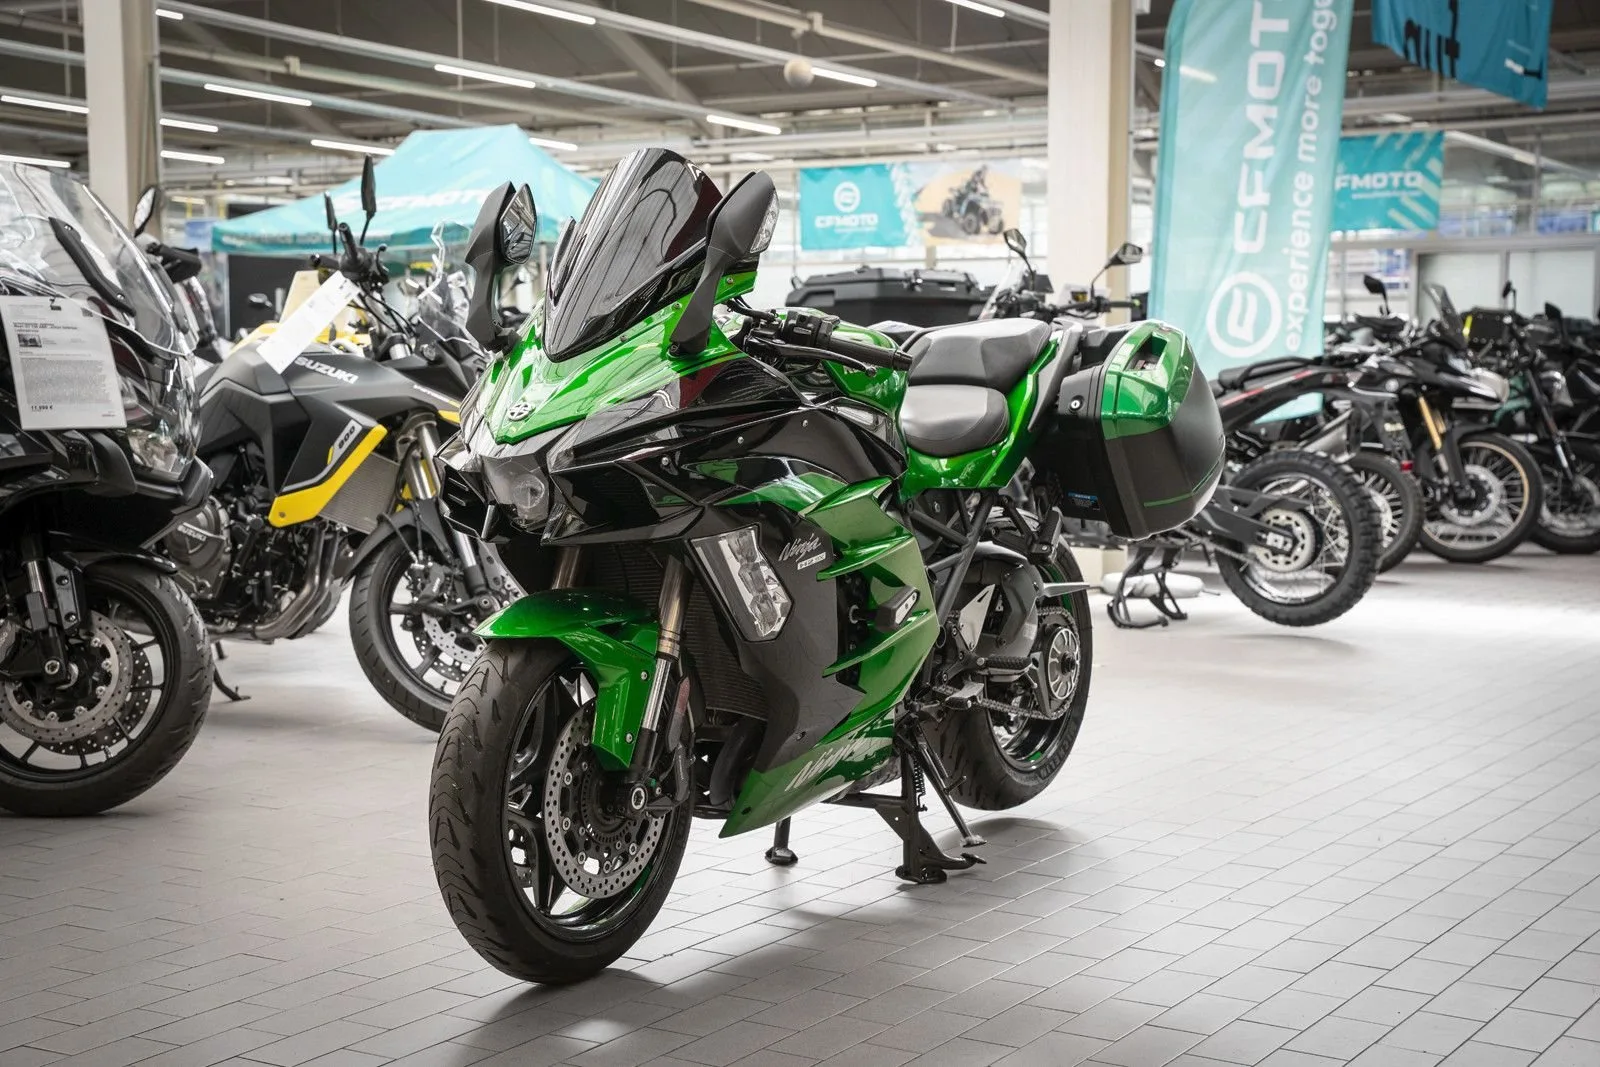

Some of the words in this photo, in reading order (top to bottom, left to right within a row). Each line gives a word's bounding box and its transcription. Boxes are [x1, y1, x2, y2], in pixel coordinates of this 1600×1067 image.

[1233, 1, 1290, 255] CFMOT
[1297, 75, 1323, 163] more
[1334, 170, 1424, 191] FMOTO
[815, 213, 878, 228] CFMOTO
[1282, 170, 1314, 351] experience
[294, 356, 359, 384] SUZUKI
[177, 524, 207, 541] SUZUKI
[778, 532, 822, 562] Ninja
[784, 731, 868, 792] Ninja
